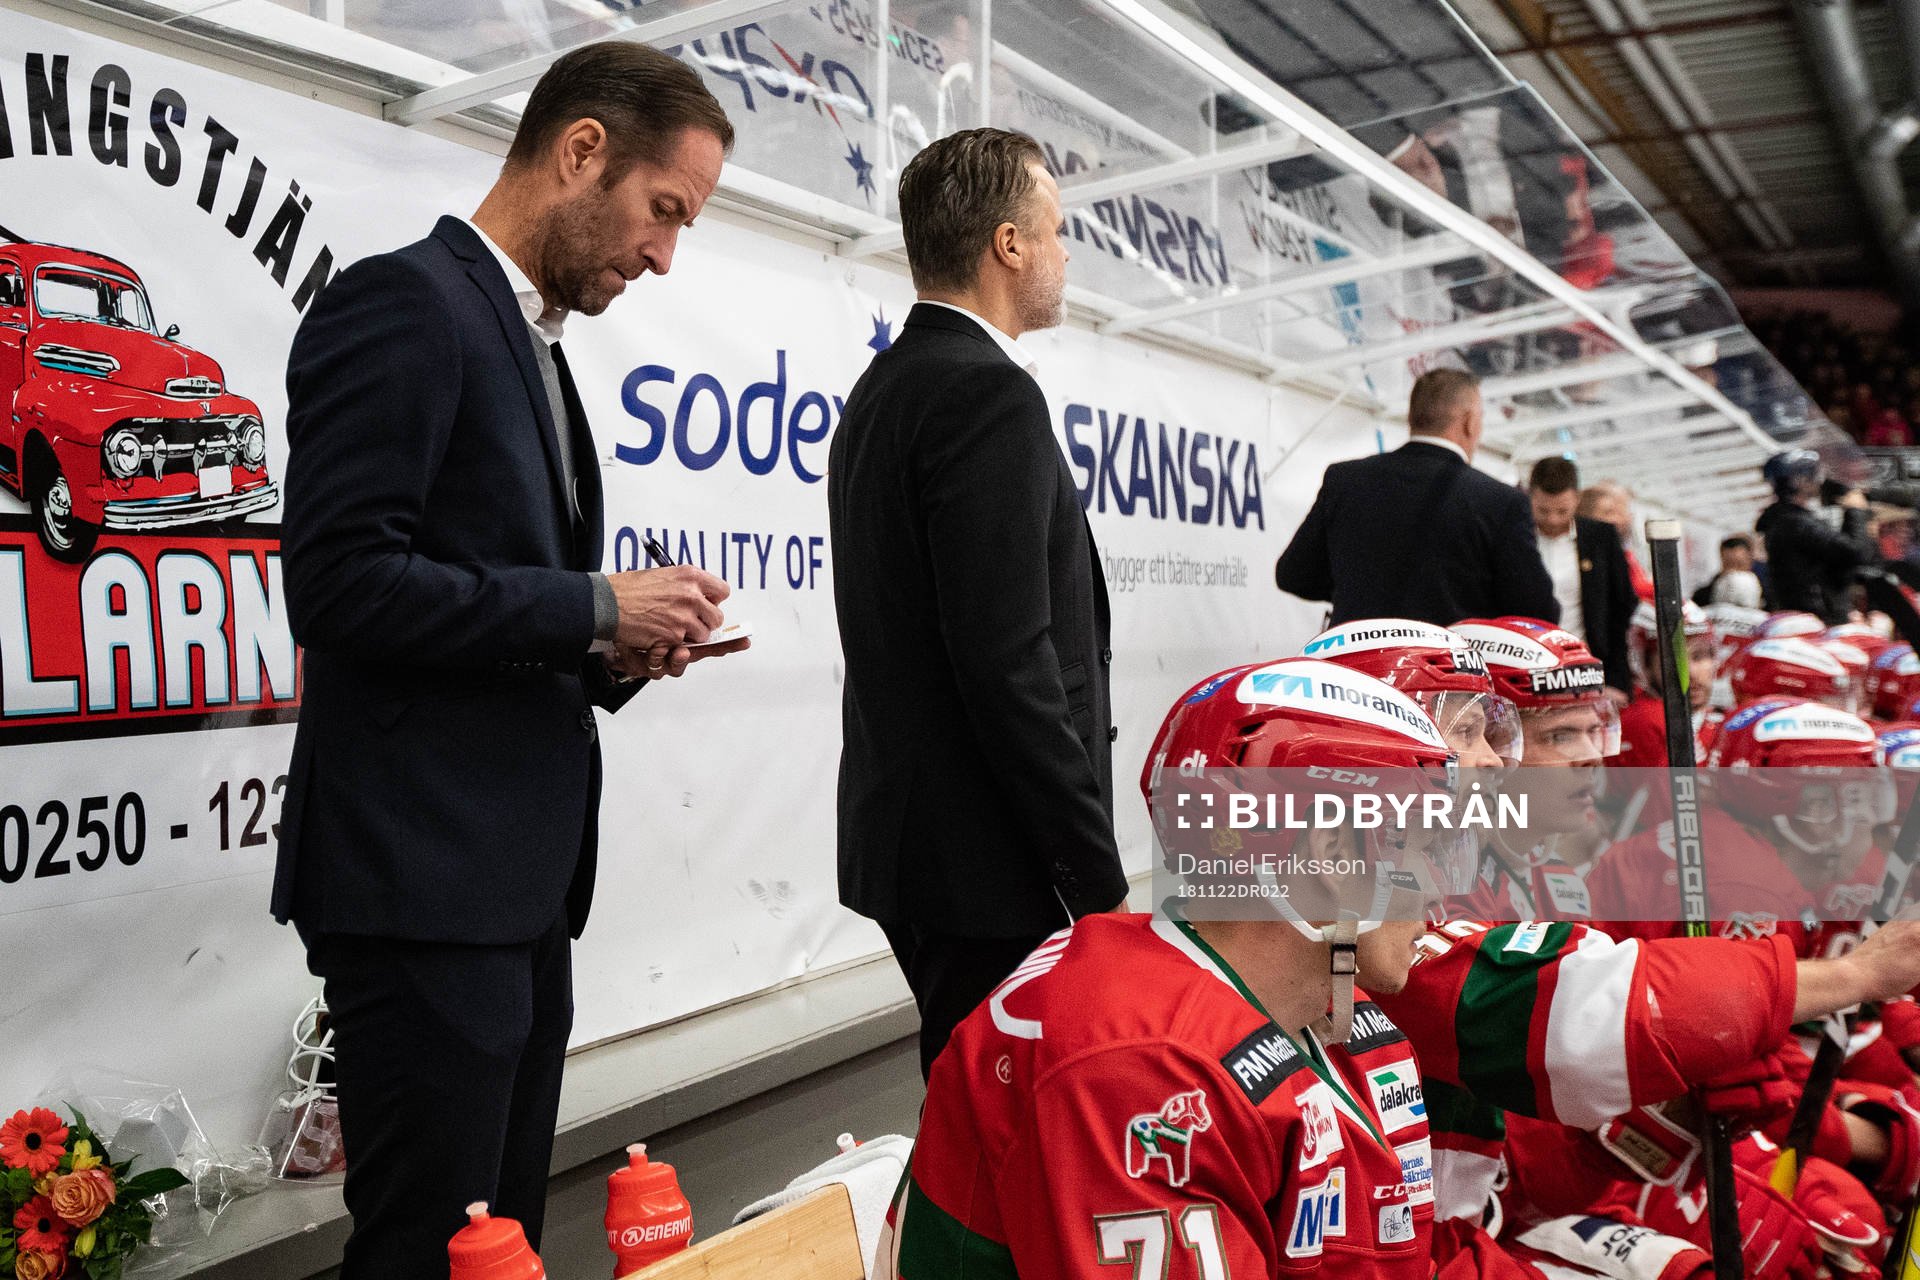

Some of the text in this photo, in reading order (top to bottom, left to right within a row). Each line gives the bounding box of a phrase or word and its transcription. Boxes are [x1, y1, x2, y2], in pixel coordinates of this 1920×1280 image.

[1064, 403, 1266, 531] SKANSKA
[786, 535, 824, 590] OF
[1105, 548, 1248, 593] bygger ett bättre samhälle
[0, 549, 297, 717] LARN
[1466, 638, 1543, 664] oramast
[1532, 670, 1567, 692] FM
[1320, 681, 1436, 742] moramast
[1178, 749, 1209, 779] dt
[1306, 765, 1380, 788] CCM
[0, 791, 146, 884] 0250
[1674, 774, 1706, 922] RIBCOR
[1390, 874, 1414, 882] CCM
[1232, 1049, 1274, 1090] FM
[1380, 1082, 1422, 1113] dalakra
[644, 1215, 692, 1243] ENERVIT
[1094, 1202, 1233, 1280] 71
